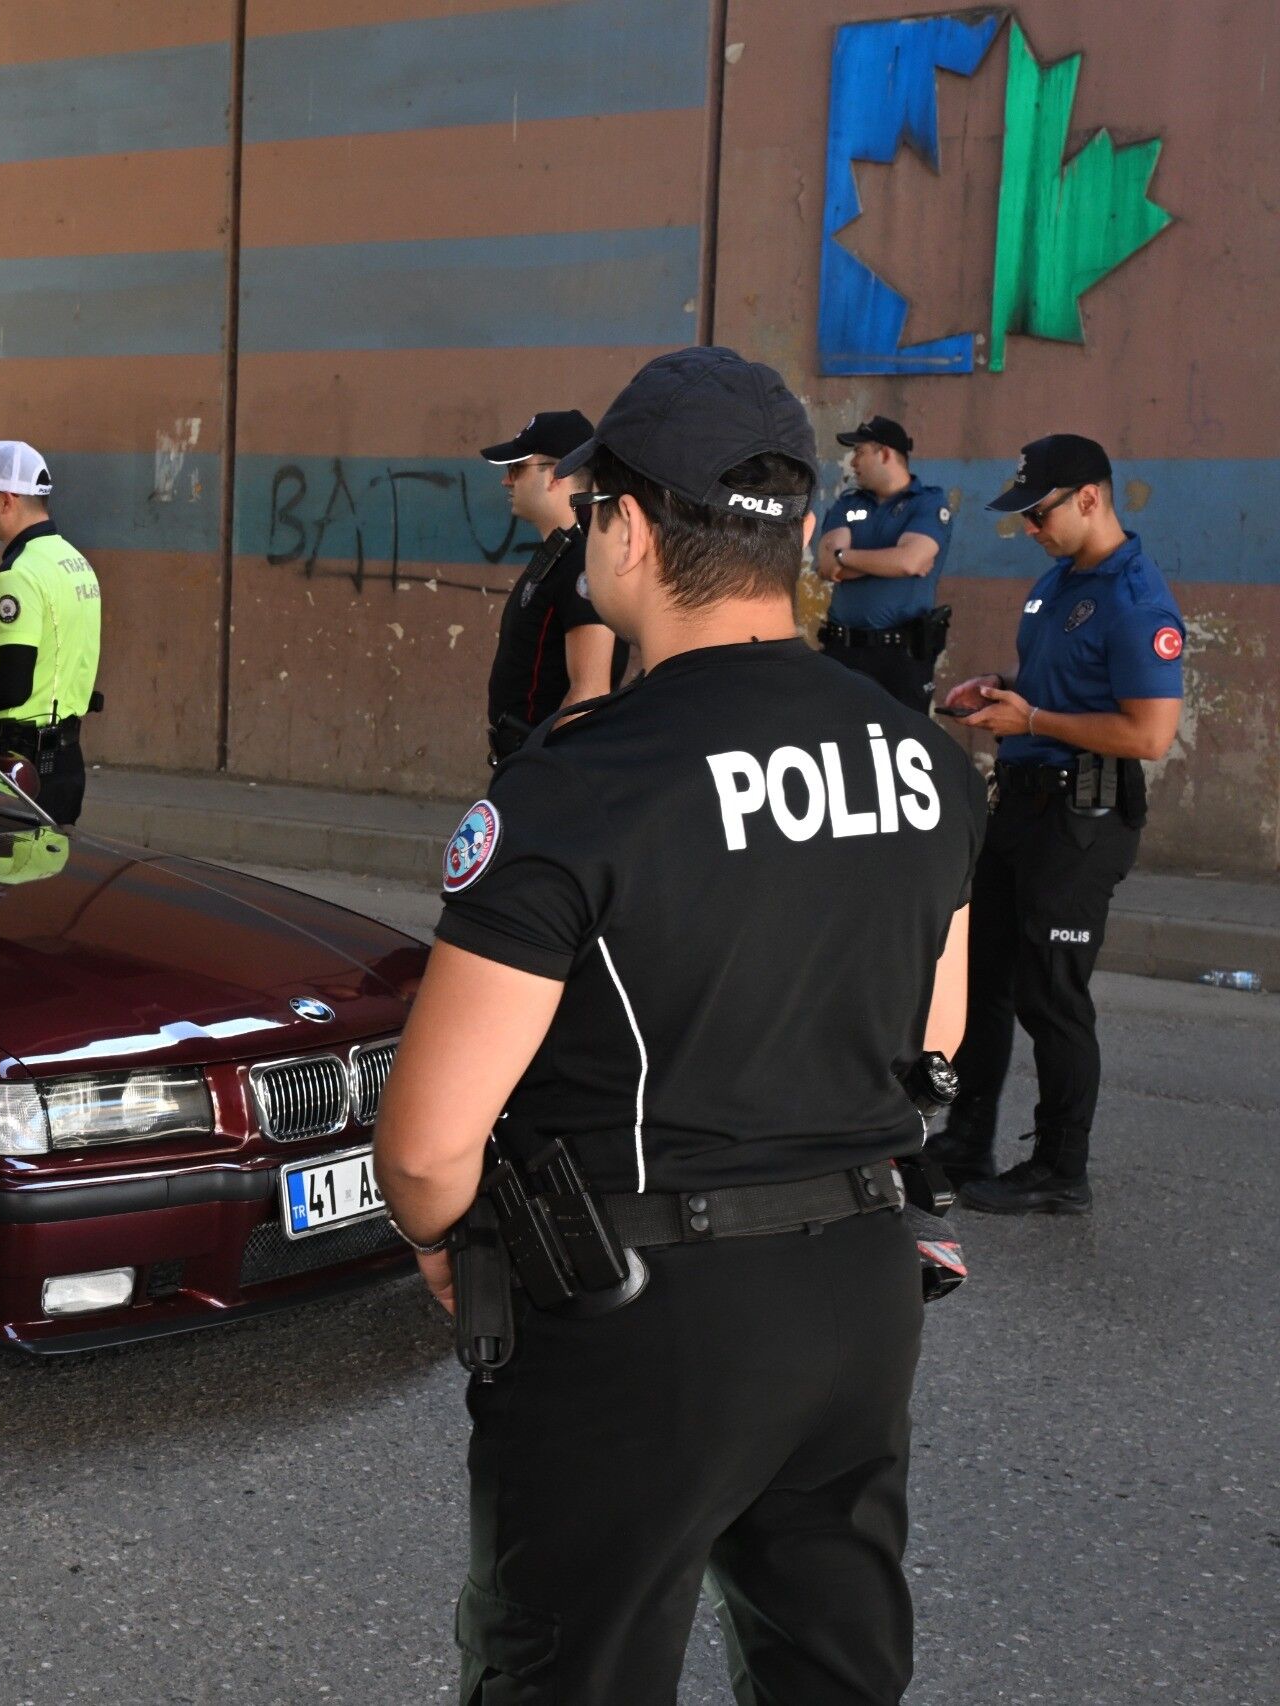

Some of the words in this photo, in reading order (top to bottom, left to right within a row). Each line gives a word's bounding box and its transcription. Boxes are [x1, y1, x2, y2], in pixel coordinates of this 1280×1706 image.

[728, 493, 784, 517] POLİS
[706, 722, 940, 851] POLİS
[309, 1169, 337, 1218] 41
[292, 1204, 306, 1220] TR
